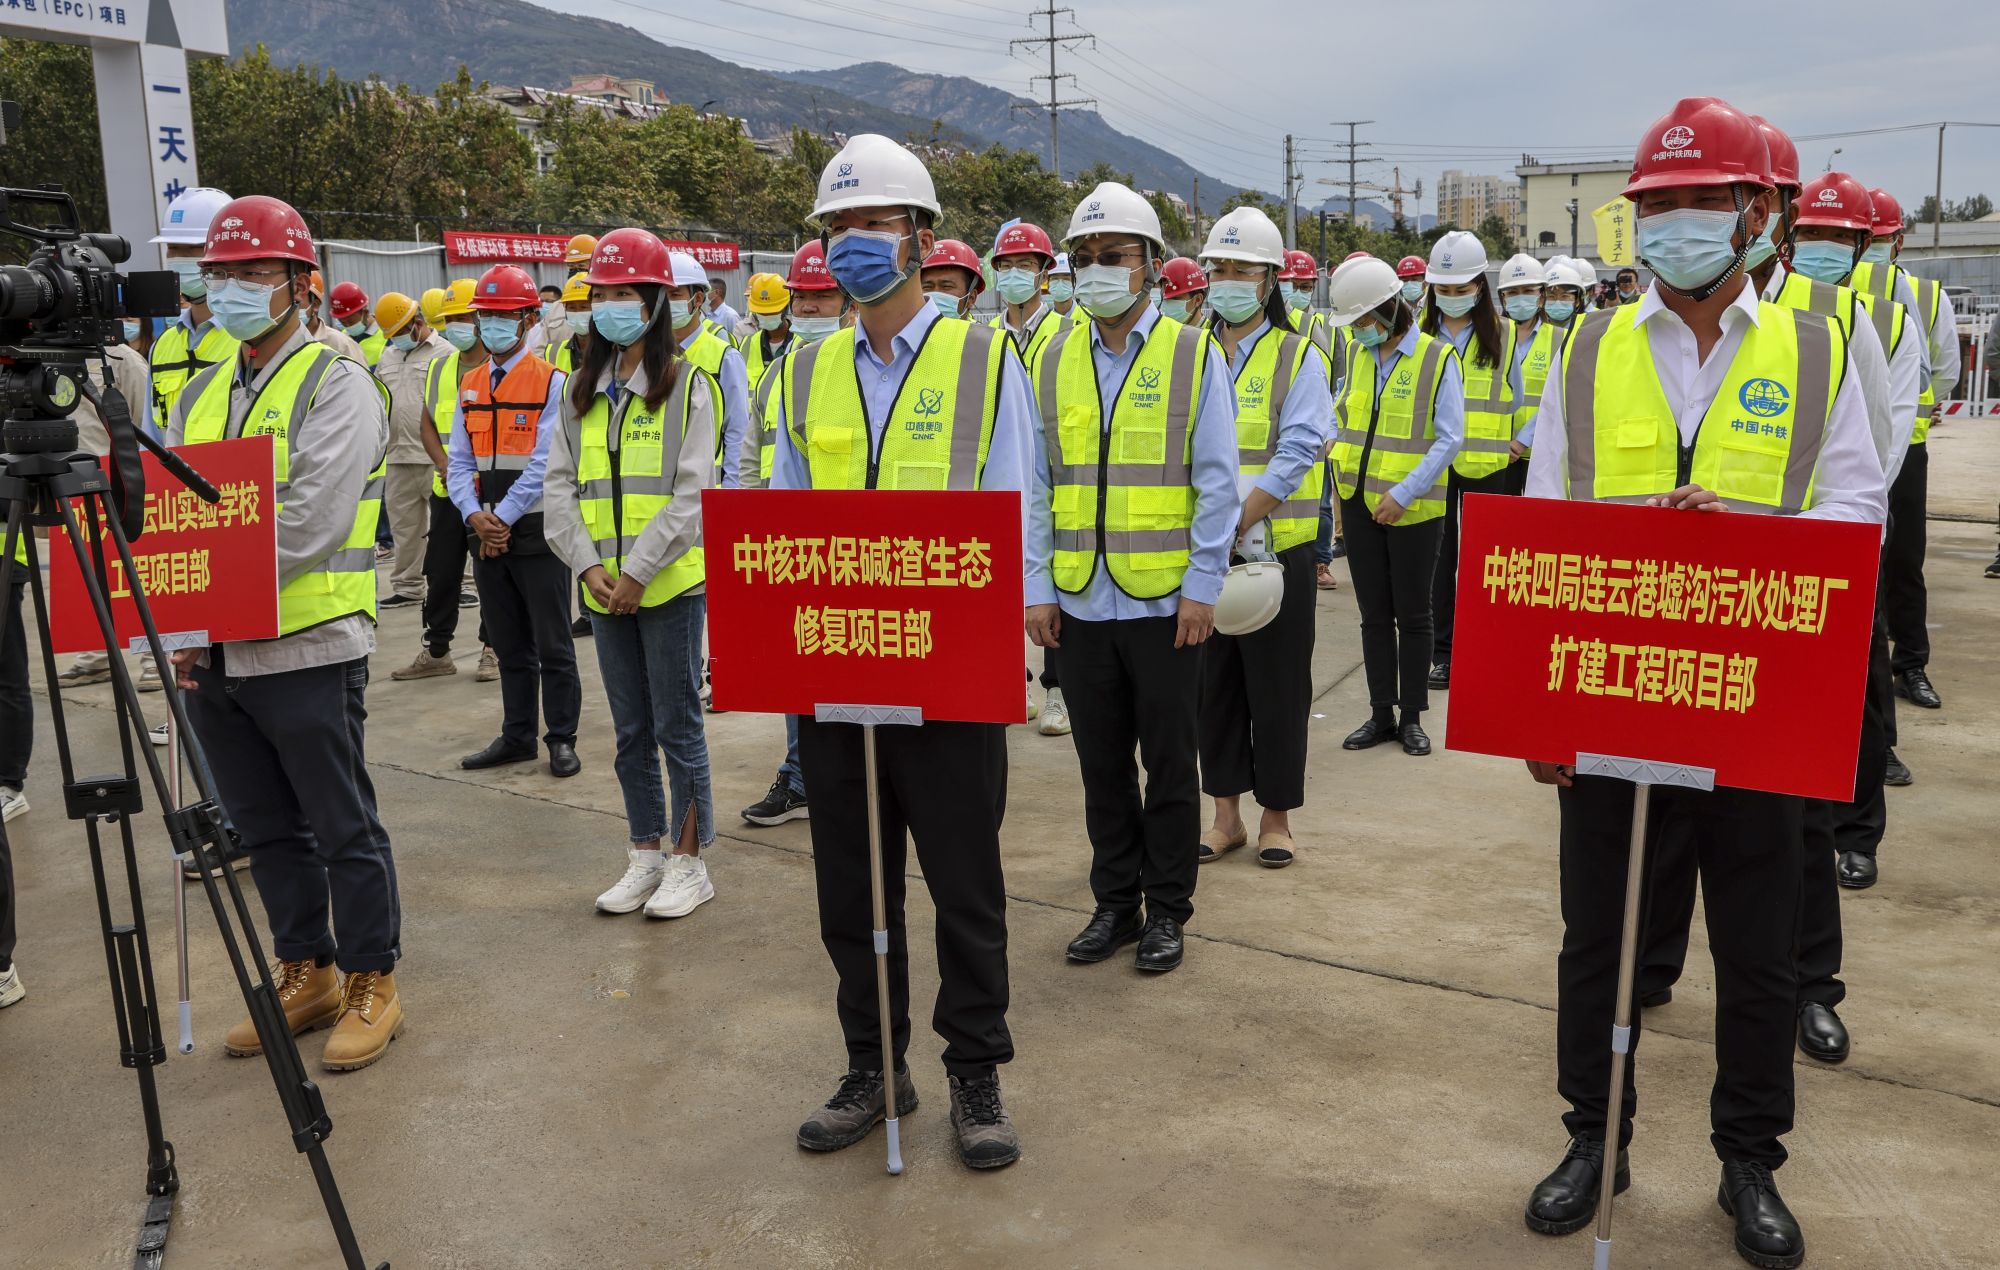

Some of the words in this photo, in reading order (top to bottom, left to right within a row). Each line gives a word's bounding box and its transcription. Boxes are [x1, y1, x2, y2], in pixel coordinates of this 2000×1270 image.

[1651, 150, 1702, 162] 中国中铁四局
[830, 178, 860, 192] 中核集团
[214, 230, 251, 242] 中国中冶
[252, 425, 287, 439] 国中冶
[905, 421, 943, 432] 中核集团
[1731, 418, 1788, 440] 中国中铁
[733, 533, 993, 588] 中核环保碱渣生态
[110, 548, 211, 598] 工程项目部
[1483, 545, 1849, 635] 中铁四局连云港墟沟污水处理厂
[794, 605, 933, 659] 修复项目部
[1547, 634, 1758, 714] 扩建工程项目部
